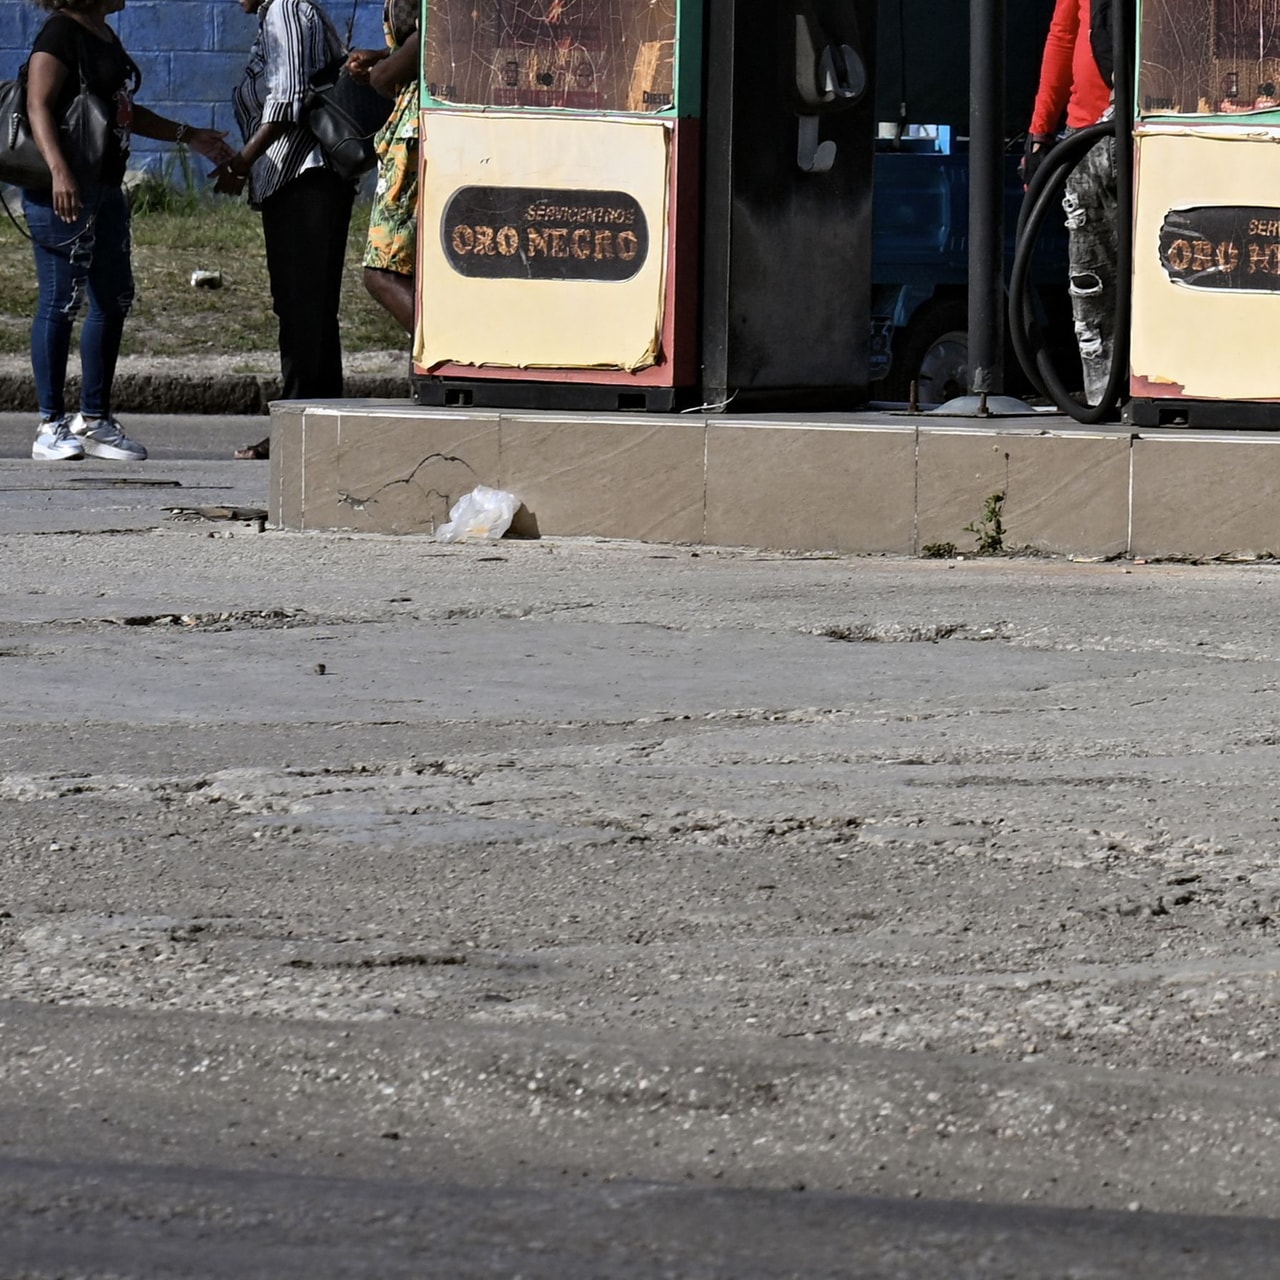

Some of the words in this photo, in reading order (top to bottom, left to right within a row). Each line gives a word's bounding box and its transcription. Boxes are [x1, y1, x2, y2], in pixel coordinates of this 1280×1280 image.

[526, 204, 634, 224] SERVICENTROS
[452, 224, 520, 257] ORO
[526, 226, 640, 261] NEGRO
[1168, 238, 1240, 273] ORO
